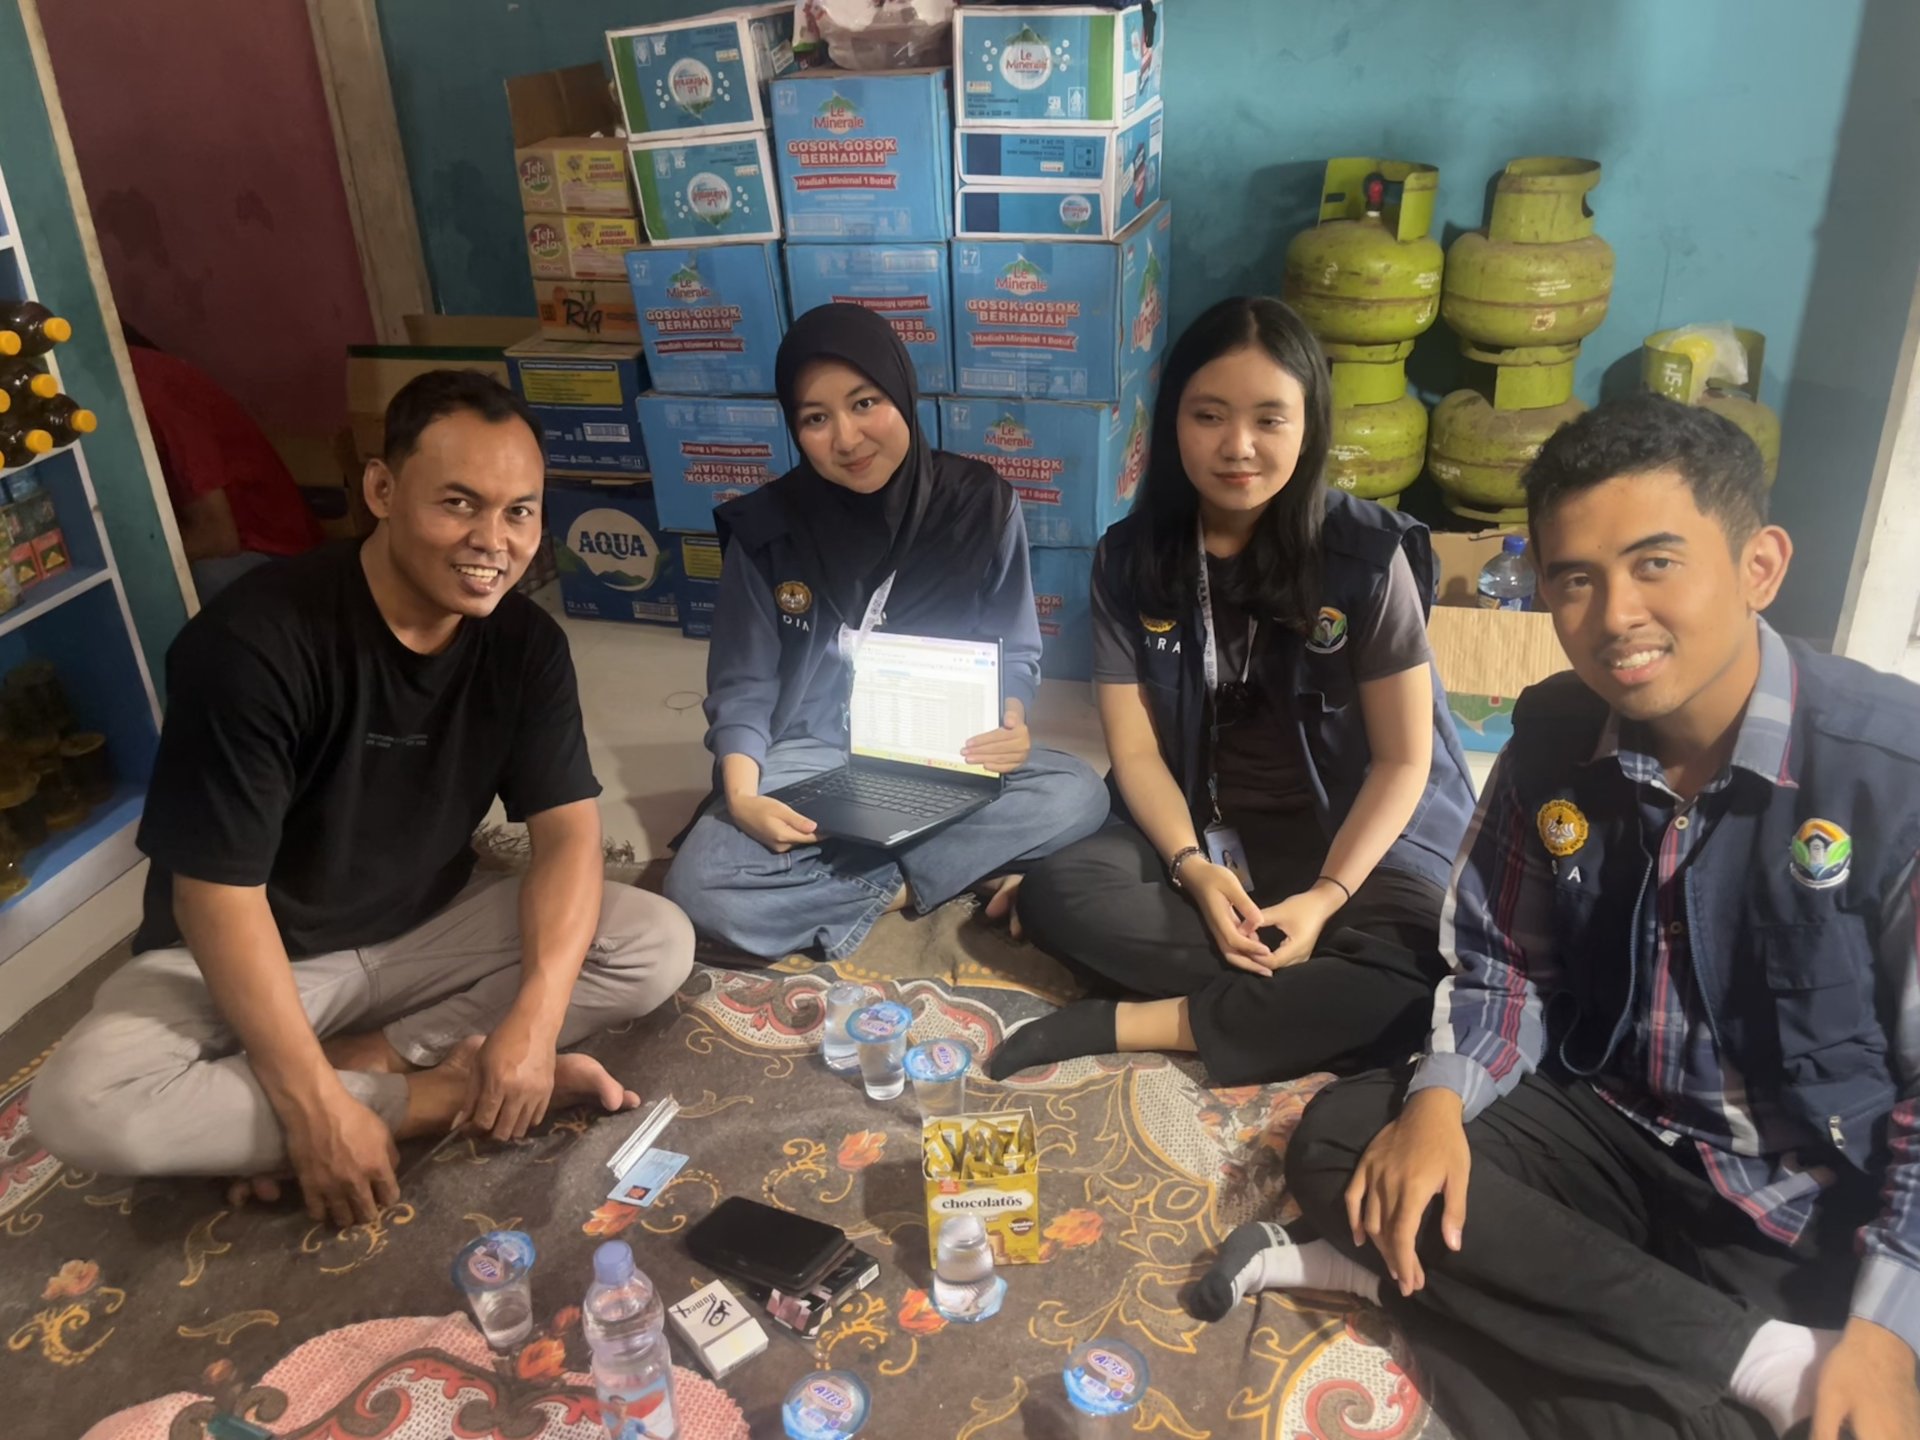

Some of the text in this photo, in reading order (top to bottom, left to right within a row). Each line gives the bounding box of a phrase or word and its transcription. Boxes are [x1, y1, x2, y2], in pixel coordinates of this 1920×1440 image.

[1020, 49, 1032, 60] Le
[830, 104, 844, 117] Le
[813, 116, 865, 129] Minerale
[788, 138, 897, 153] GOSOK-GOSOK
[799, 152, 885, 164] BERHADIAH
[525, 161, 545, 175] Teh
[829, 176, 862, 185] Minimal
[533, 227, 555, 241] Teh
[1013, 265, 1028, 279] Le
[680, 279, 692, 288] Le
[995, 277, 1048, 292] Minerale
[666, 286, 711, 299] Minerale
[968, 299, 1079, 314] GOSOK-GOSOK
[646, 307, 740, 321] GOSOK-GOSOK
[979, 312, 1065, 324] BERHADIAH
[658, 319, 732, 331] BERHADIAH
[1001, 423, 1015, 436] Le
[984, 433, 1033, 449] Minerale
[578, 530, 648, 560] AQUA
